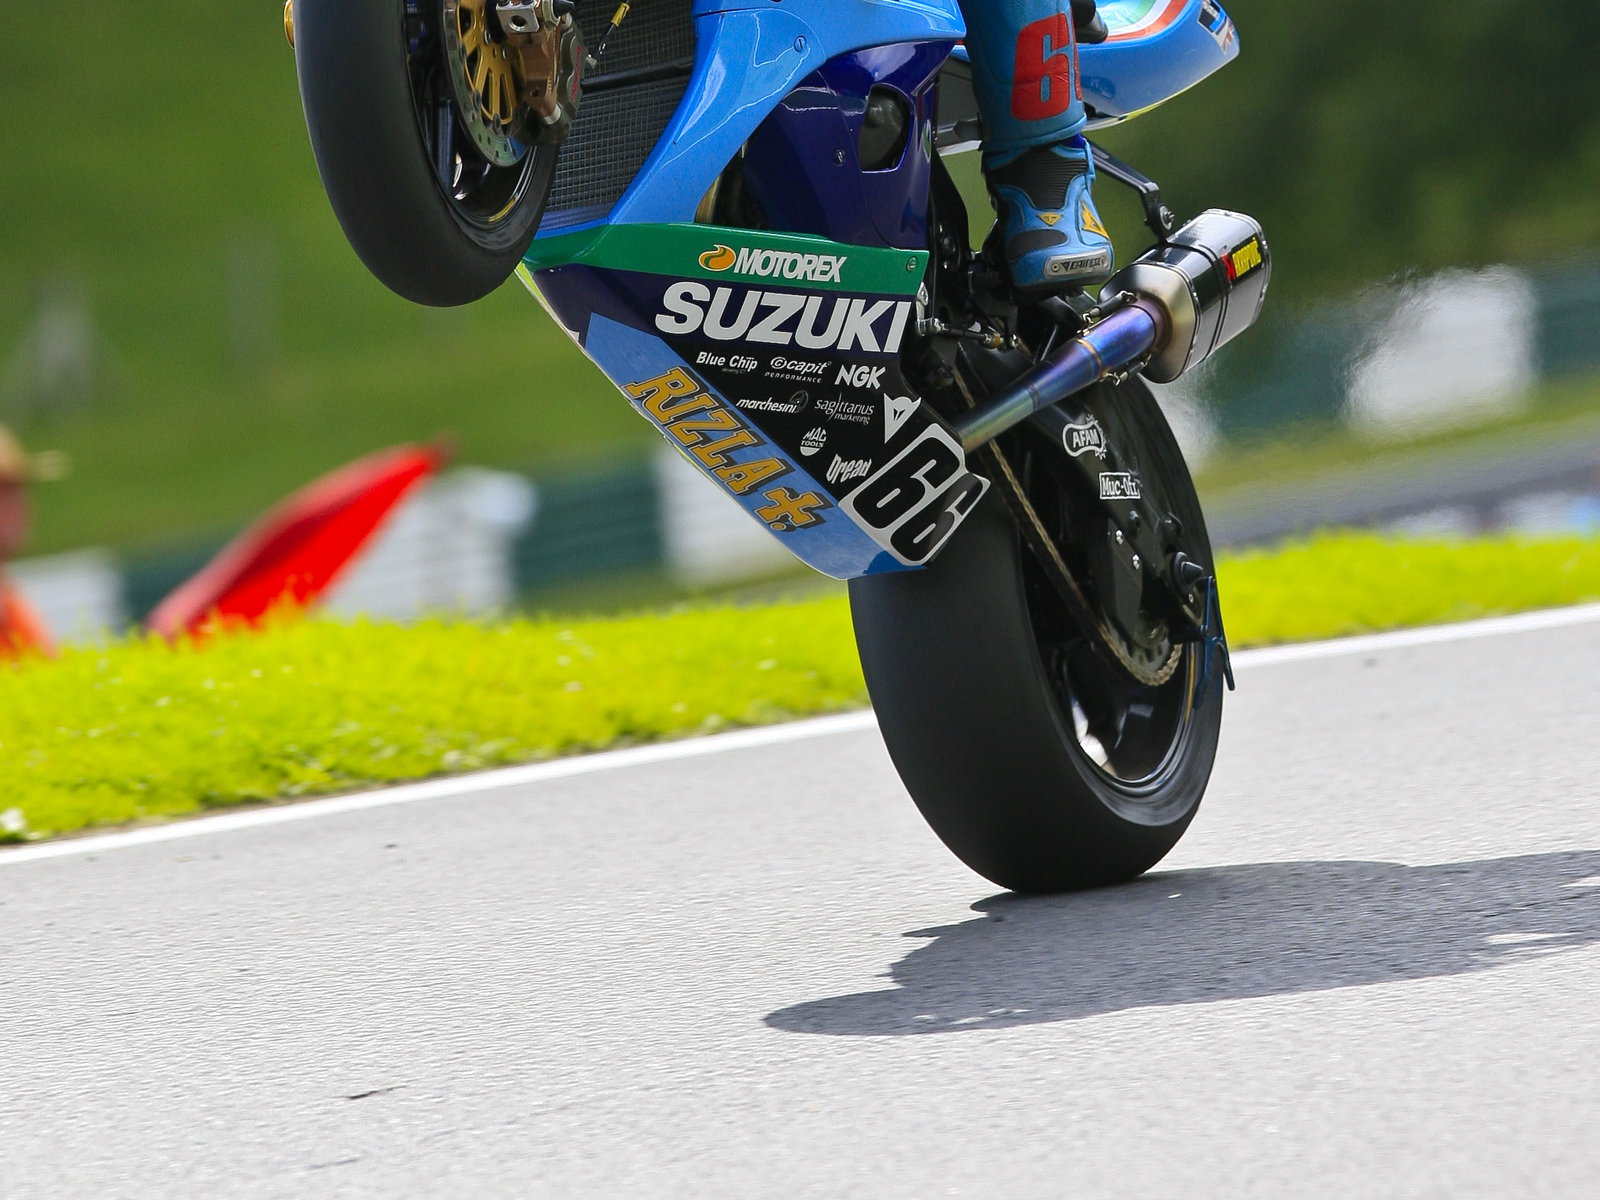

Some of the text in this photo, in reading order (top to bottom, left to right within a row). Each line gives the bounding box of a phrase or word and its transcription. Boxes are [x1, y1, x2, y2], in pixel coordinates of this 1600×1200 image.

[733, 248, 847, 283] MOTOREX
[655, 281, 911, 353] SUZUKI
[696, 351, 726, 367] Blue
[729, 355, 758, 373] Chip
[764, 371, 822, 384] PERFORMANCE
[834, 365, 886, 390] NGK
[736, 397, 801, 414] marchesini
[814, 392, 875, 421] sagittarius
[803, 427, 827, 442] MAC
[1072, 428, 1100, 449] AFAM
[852, 437, 984, 562] 66
